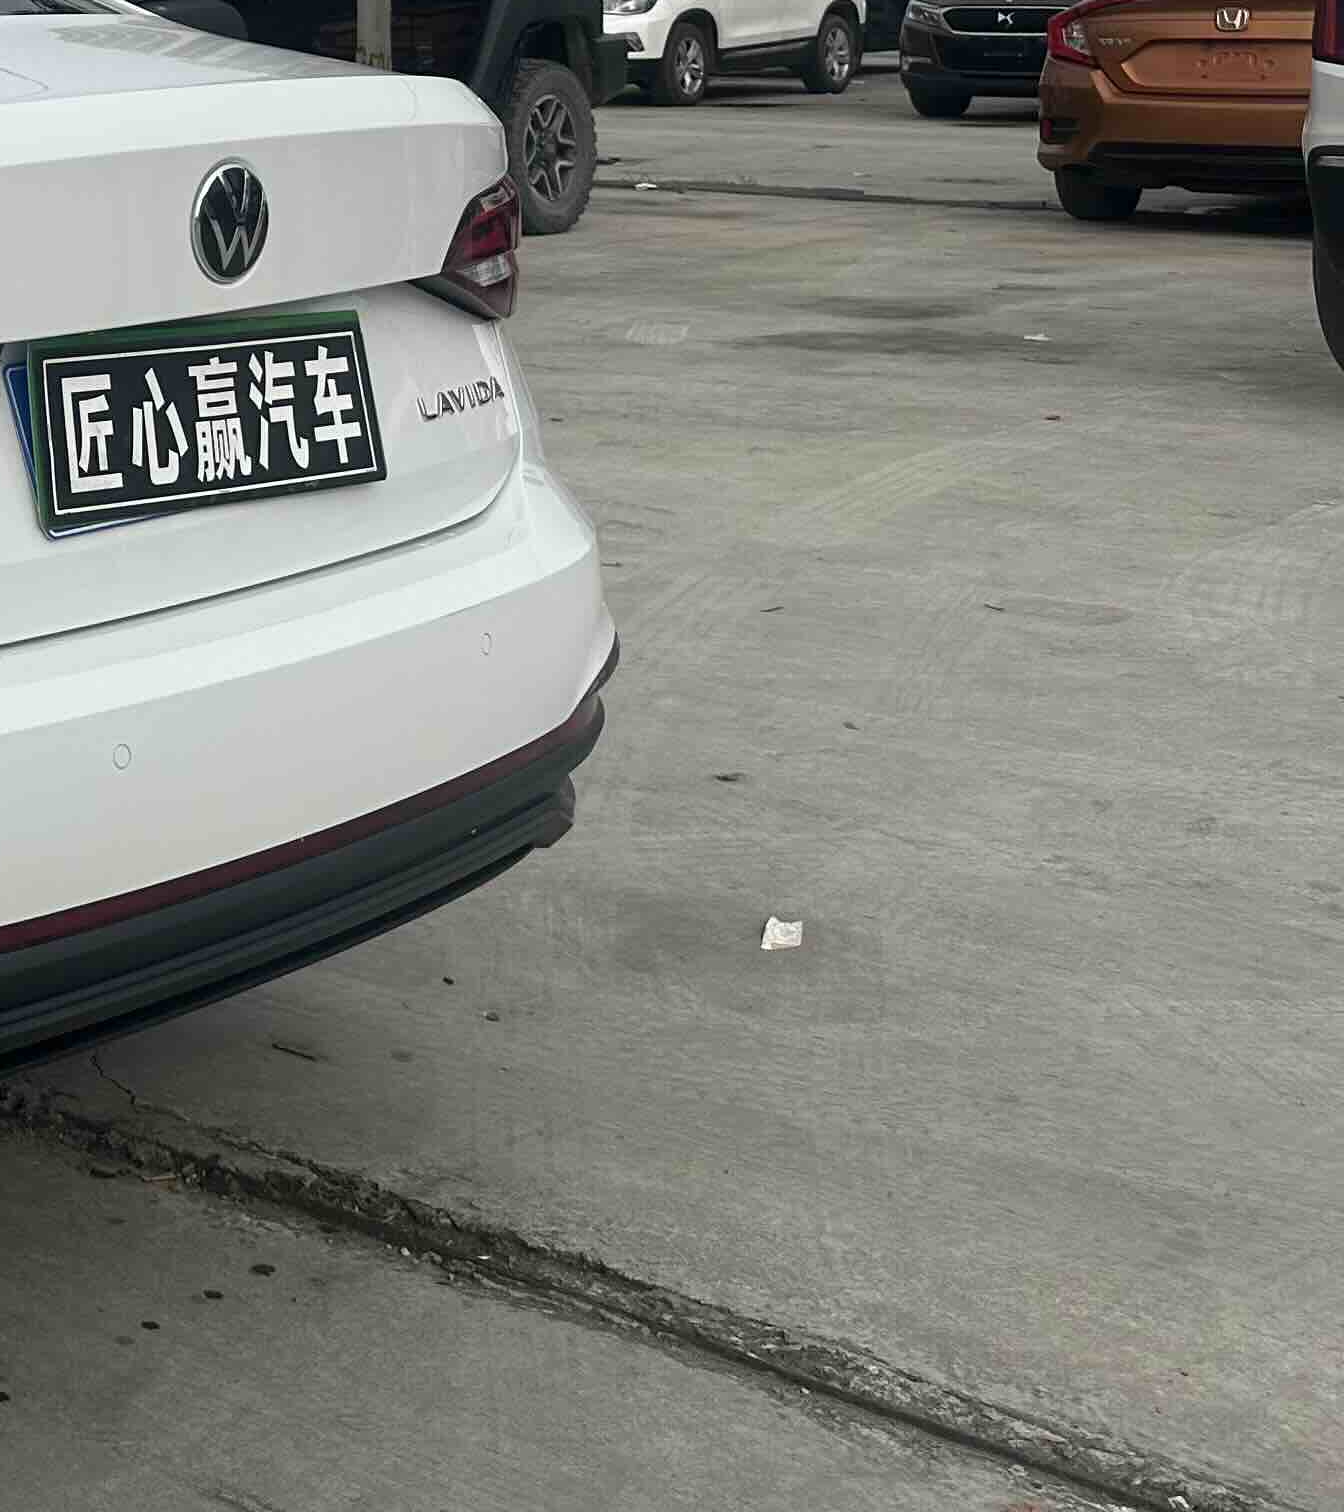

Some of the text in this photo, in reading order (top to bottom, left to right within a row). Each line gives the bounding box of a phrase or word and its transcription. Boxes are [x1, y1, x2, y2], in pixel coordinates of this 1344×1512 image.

[60, 344, 362, 494] 匠心赢汽车
[417, 376, 506, 422] LAVIDA
